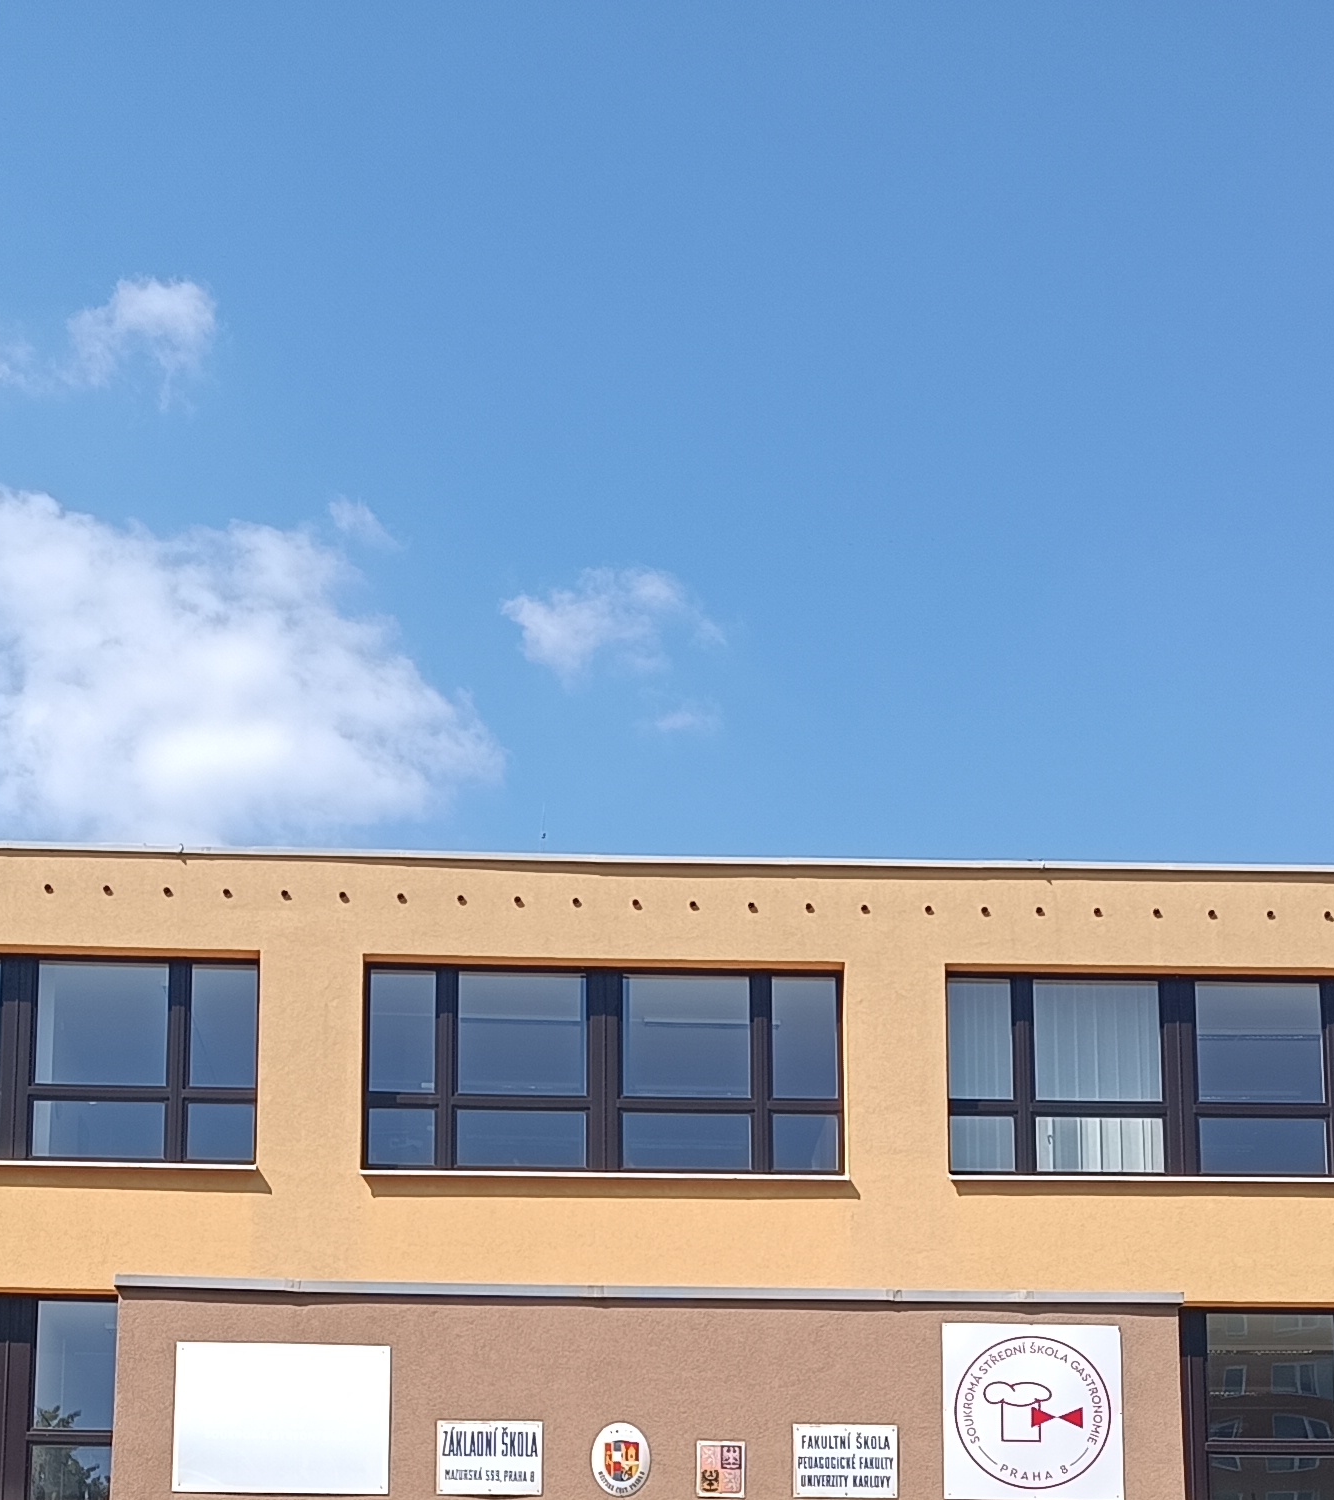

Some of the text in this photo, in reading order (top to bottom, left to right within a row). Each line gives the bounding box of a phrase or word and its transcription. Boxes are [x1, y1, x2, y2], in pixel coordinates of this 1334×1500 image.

[963, 1342, 1102, 1446] SOUKROMÁ STŘEDNÍ ŠKOLA GASTRONOMIE
[442, 1426, 538, 1457] ZÁKLADNÍ ŠKOLA
[801, 1432, 891, 1450] FAKULTNÍ ŠKOLA
[797, 1453, 893, 1470] PEDAGOGICKÉ FAKULTY
[444, 1467, 482, 1481] MAZURSKÁ
[504, 1470, 528, 1482] PRAHA
[530, 1471, 535, 1482] 8
[999, 1463, 1069, 1481] PRAHA 8
[800, 1475, 891, 1488] UNIVERZITY KARLOVY
